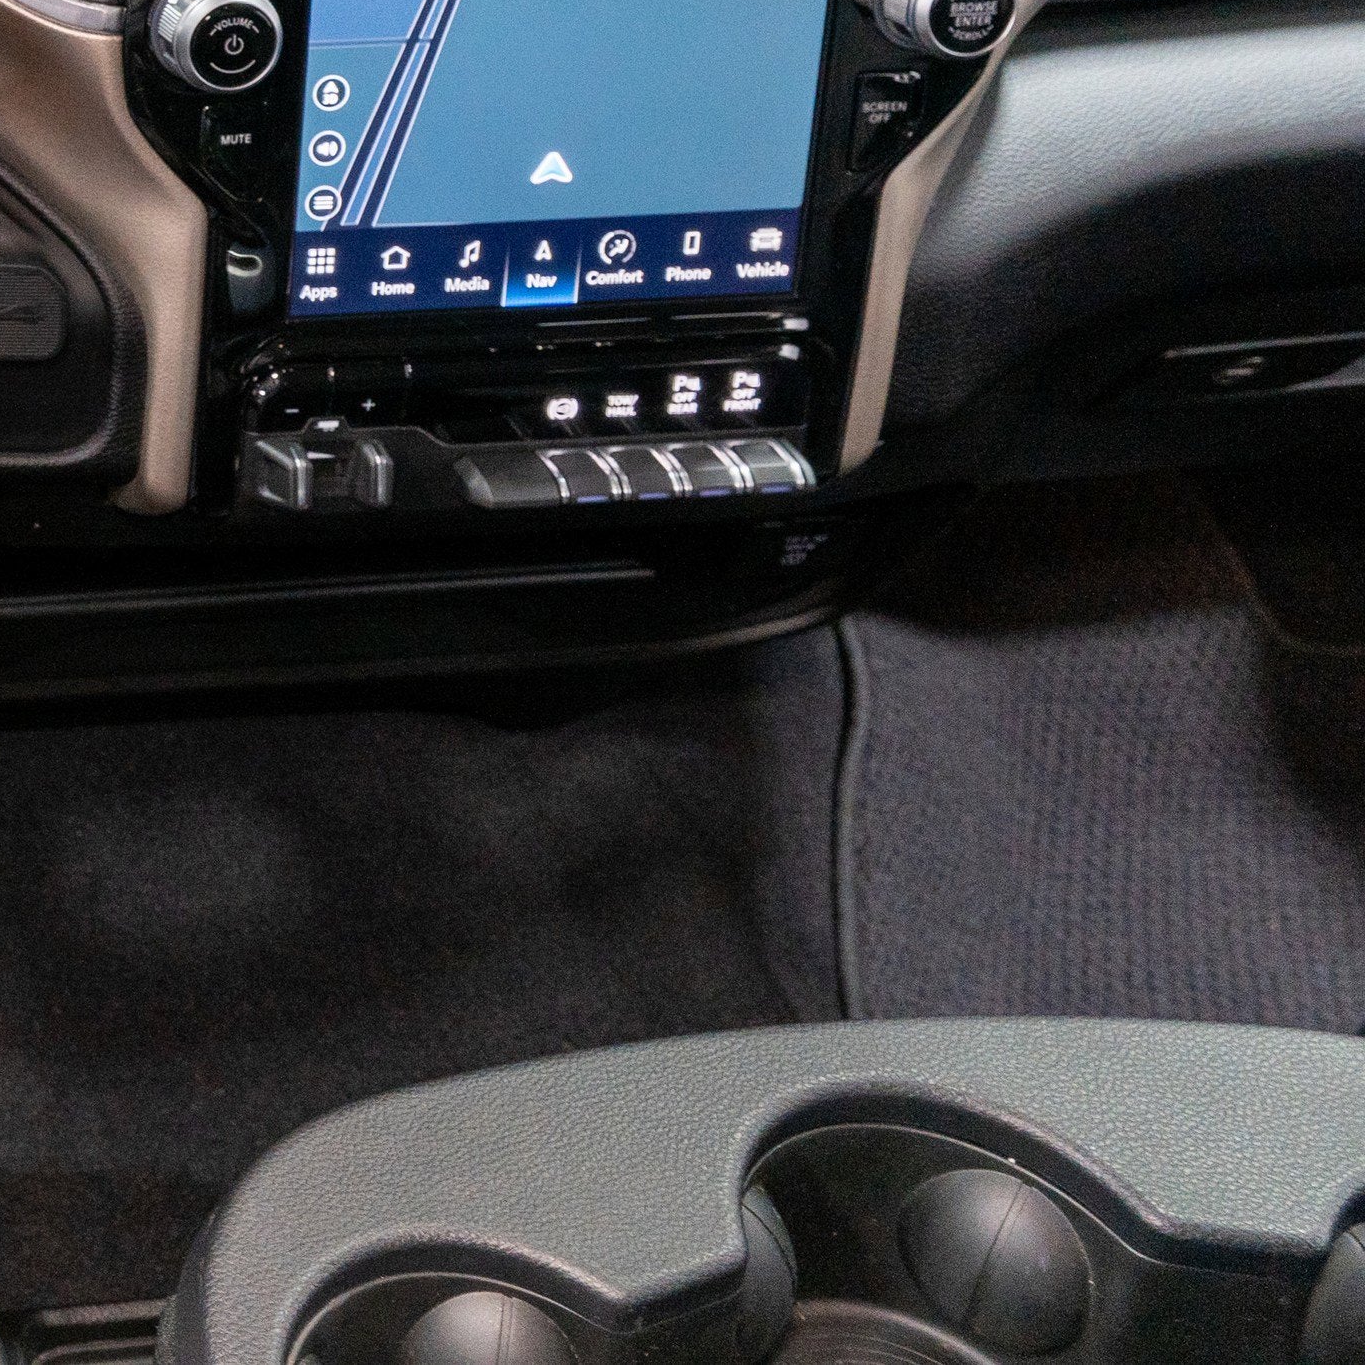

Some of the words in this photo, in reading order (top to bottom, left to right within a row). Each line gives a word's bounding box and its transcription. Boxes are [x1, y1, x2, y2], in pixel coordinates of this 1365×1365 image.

[214, 17, 254, 31] VOLUME
[862, 101, 908, 114] SCREEN
[869, 113, 891, 124] OFF
[220, 133, 252, 146] MUTE
[585, 269, 644, 285] Comfort
[665, 266, 712, 282] Phone
[735, 260, 790, 279] Vehicle
[444, 276, 490, 293] Media
[525, 273, 558, 288] Nav
[299, 284, 338, 302] Apps
[370, 281, 415, 296] Home
